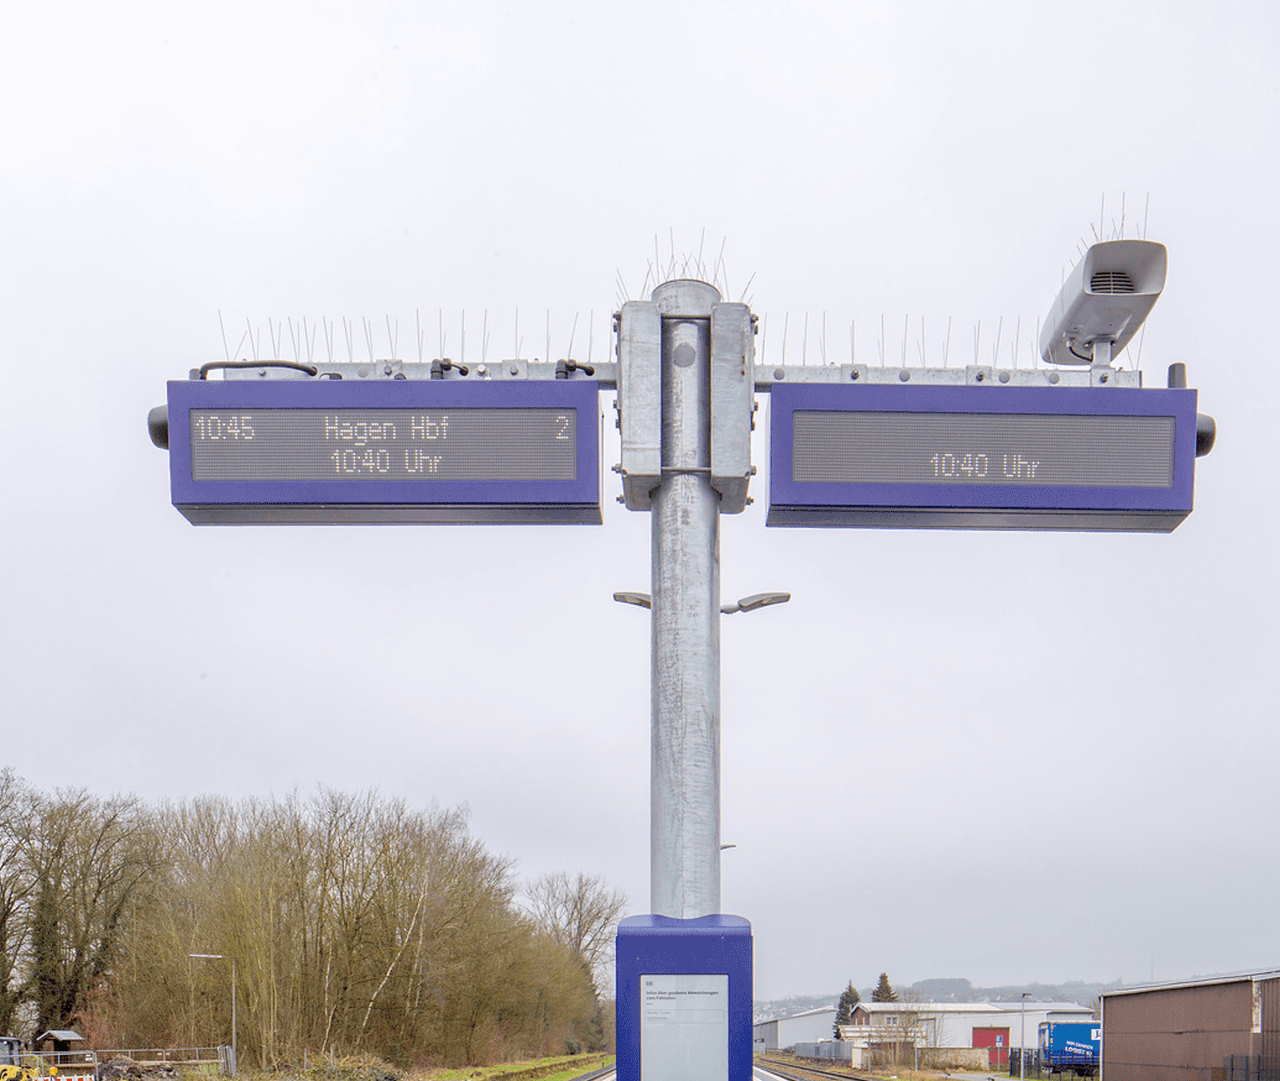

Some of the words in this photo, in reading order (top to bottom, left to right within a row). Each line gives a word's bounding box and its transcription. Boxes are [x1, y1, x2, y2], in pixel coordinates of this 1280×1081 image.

[195, 415, 256, 440] 10:45
[324, 415, 397, 446] Hagen
[410, 415, 449, 440] Hbf
[555, 415, 570, 440] 2
[330, 449, 390, 473] 10:40
[404, 449, 443, 473] Uhr
[930, 453, 989, 477] 10:40
[1003, 454, 1041, 478] Uhr
